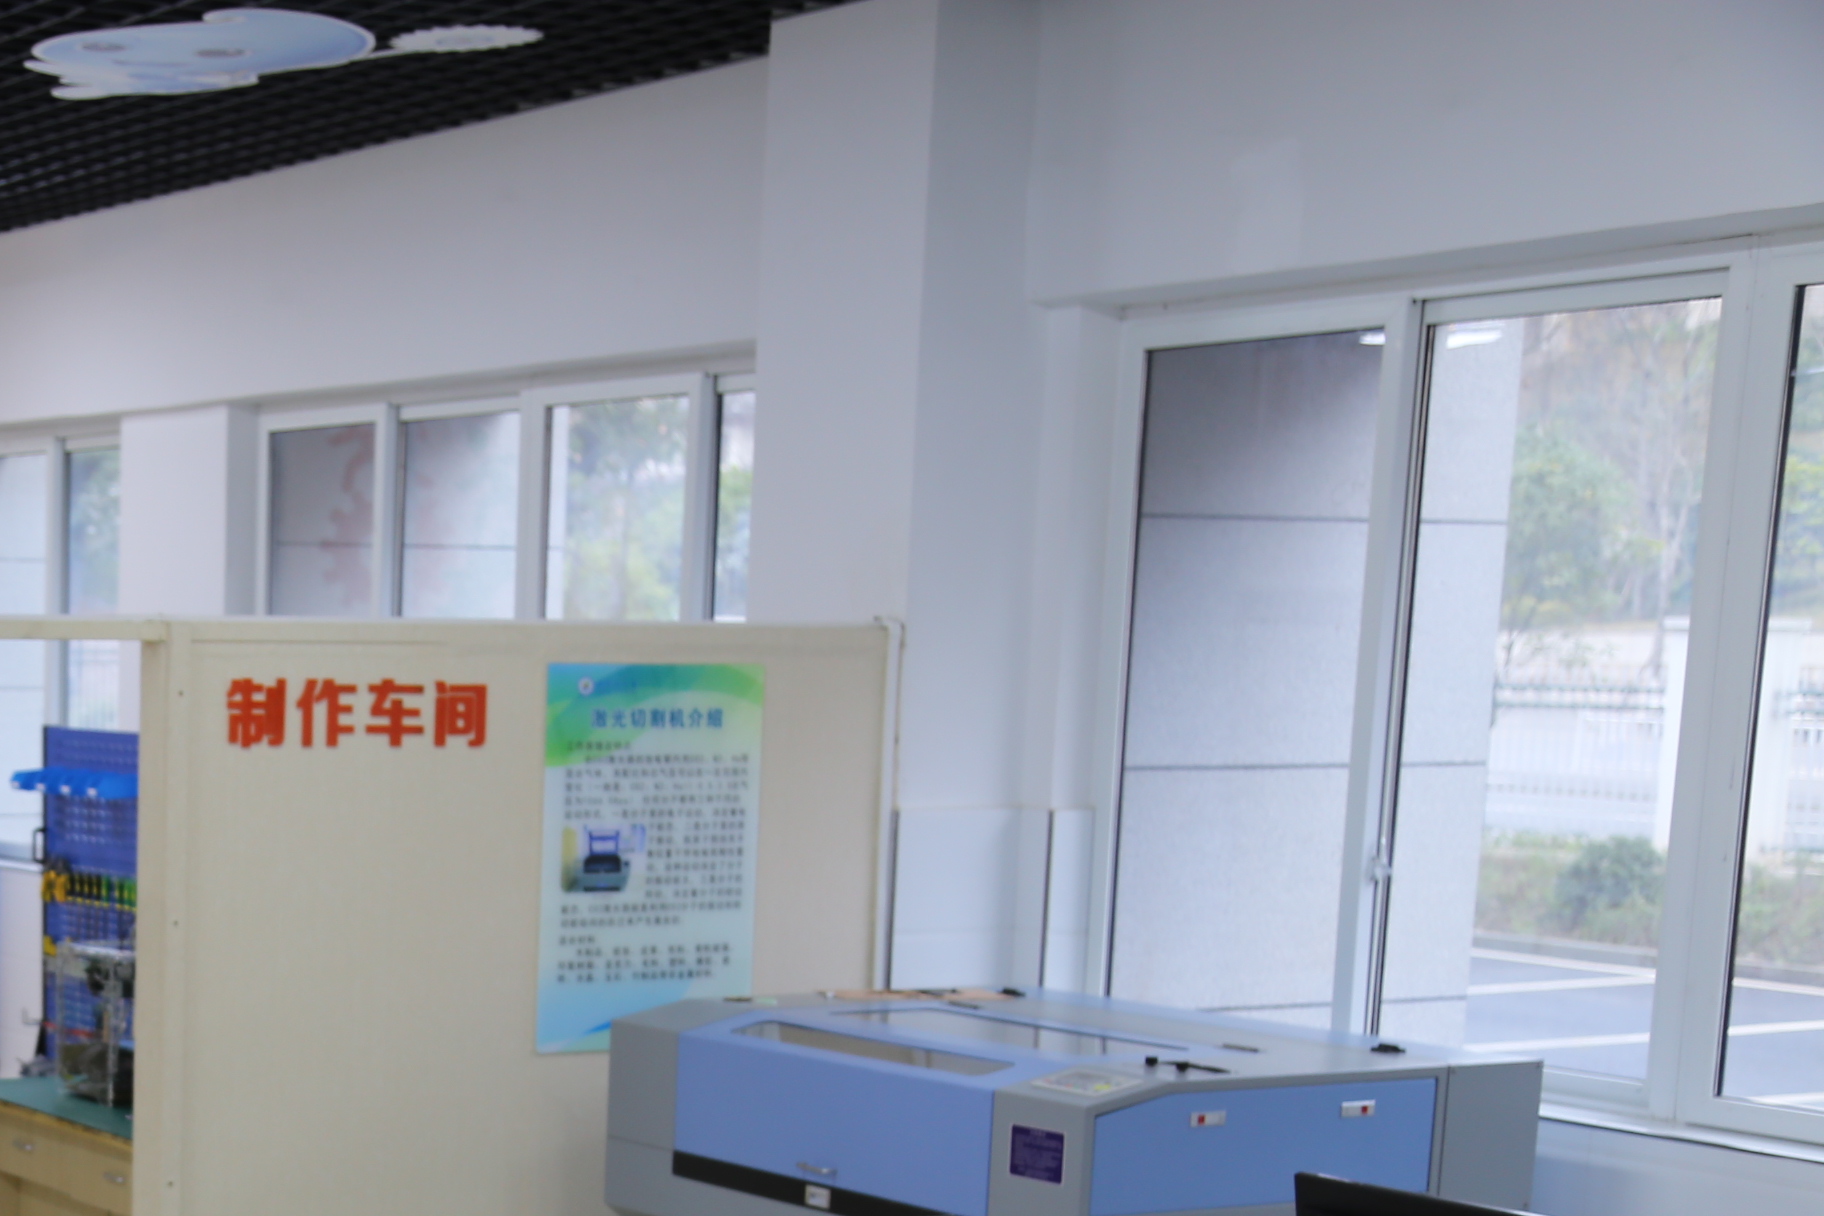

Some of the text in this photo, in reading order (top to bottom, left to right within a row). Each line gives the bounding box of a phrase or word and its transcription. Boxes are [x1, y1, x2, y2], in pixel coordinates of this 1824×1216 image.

[226, 677, 487, 749] 制作车间
[591, 708, 724, 729] 激光切割机介绍
